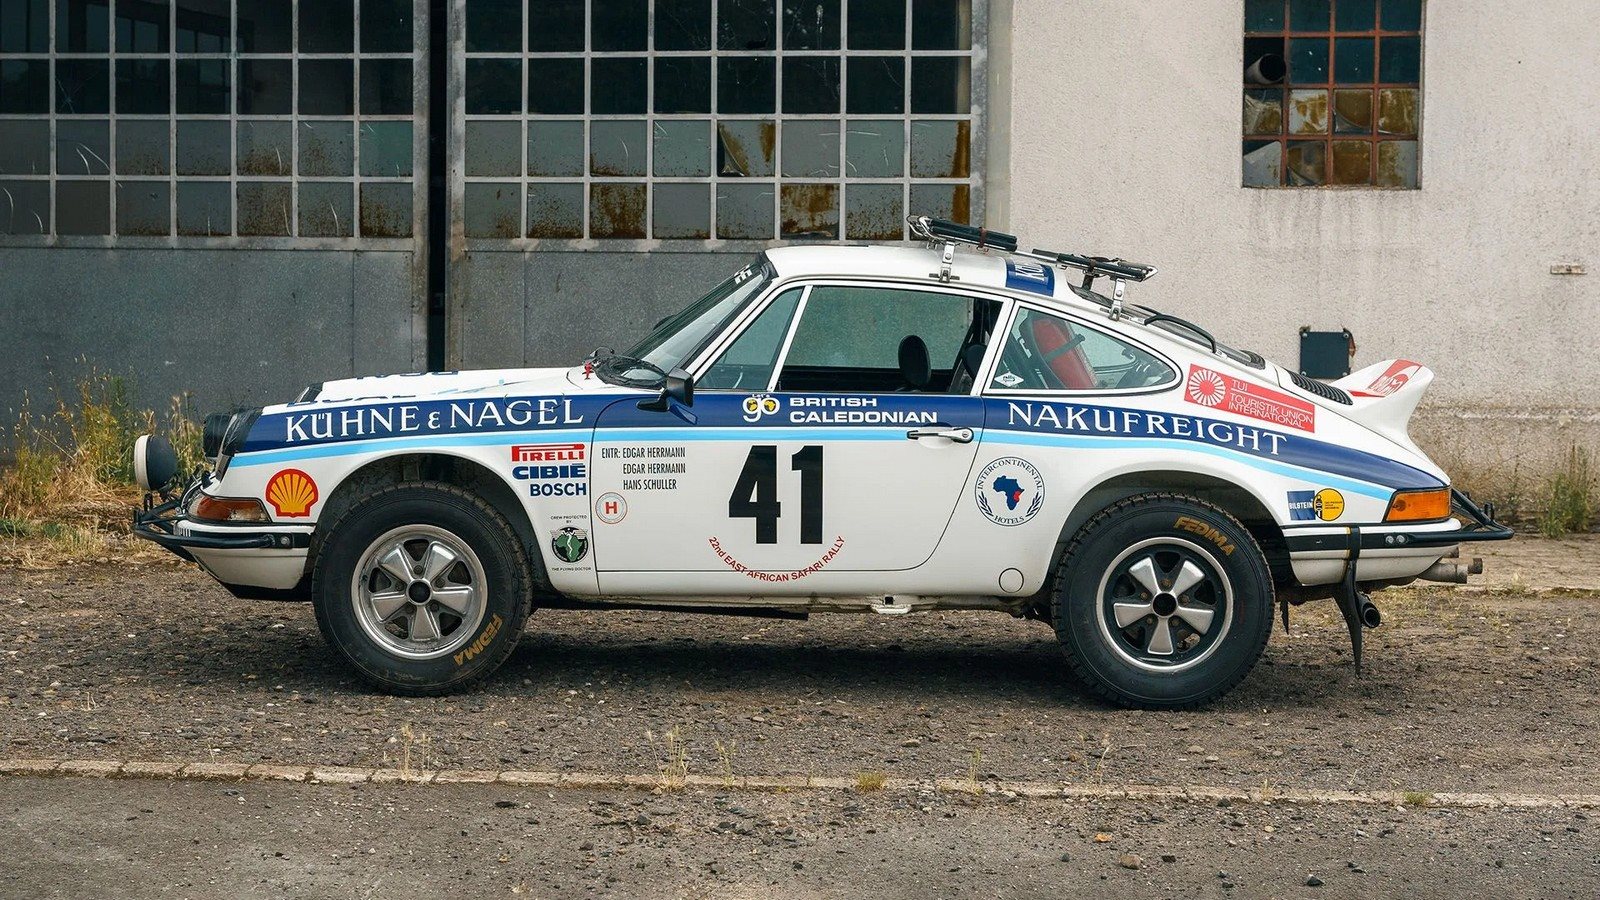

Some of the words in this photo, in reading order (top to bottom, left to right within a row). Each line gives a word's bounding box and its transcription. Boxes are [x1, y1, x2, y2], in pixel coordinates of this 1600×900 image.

[1232, 379, 1248, 392] TUI
[742, 397, 781, 423] go
[789, 397, 877, 407] BRITISH
[1230, 393, 1280, 415] TOURISTIK
[1281, 408, 1313, 424] UNION
[285, 405, 420, 443] KÜHNE
[450, 399, 584, 429] NAGEL
[789, 411, 938, 423] CALEDONIAN
[1228, 402, 1306, 429] INTERNATIONAL
[1007, 402, 1288, 456] NAKUFREIGHT
[511, 443, 586, 462] PIRELLI
[601, 447, 621, 459] ENTR:
[622, 447, 646, 459] EDGAR
[647, 446, 686, 458] HERRMANN
[622, 463, 646, 475] EDGAR
[647, 462, 686, 474] HERRMANN
[977, 459, 1043, 490] INTERCONTINENTAL
[530, 482, 587, 497] BOSCH
[623, 479, 642, 490] HANS
[643, 478, 677, 490] SCHULLER
[728, 444, 824, 545] 41
[605, 501, 618, 515] H
[994, 515, 1025, 524] HOTELS
[1173, 516, 1235, 556] FEDIMA
[708, 536, 726, 558] 22nd
[723, 555, 748, 573] EAST
[746, 570, 789, 582] AFRICAN
[791, 560, 824, 580] SAFARI
[822, 535, 845, 564] RALLY
[453, 612, 503, 667] FEDIMA
